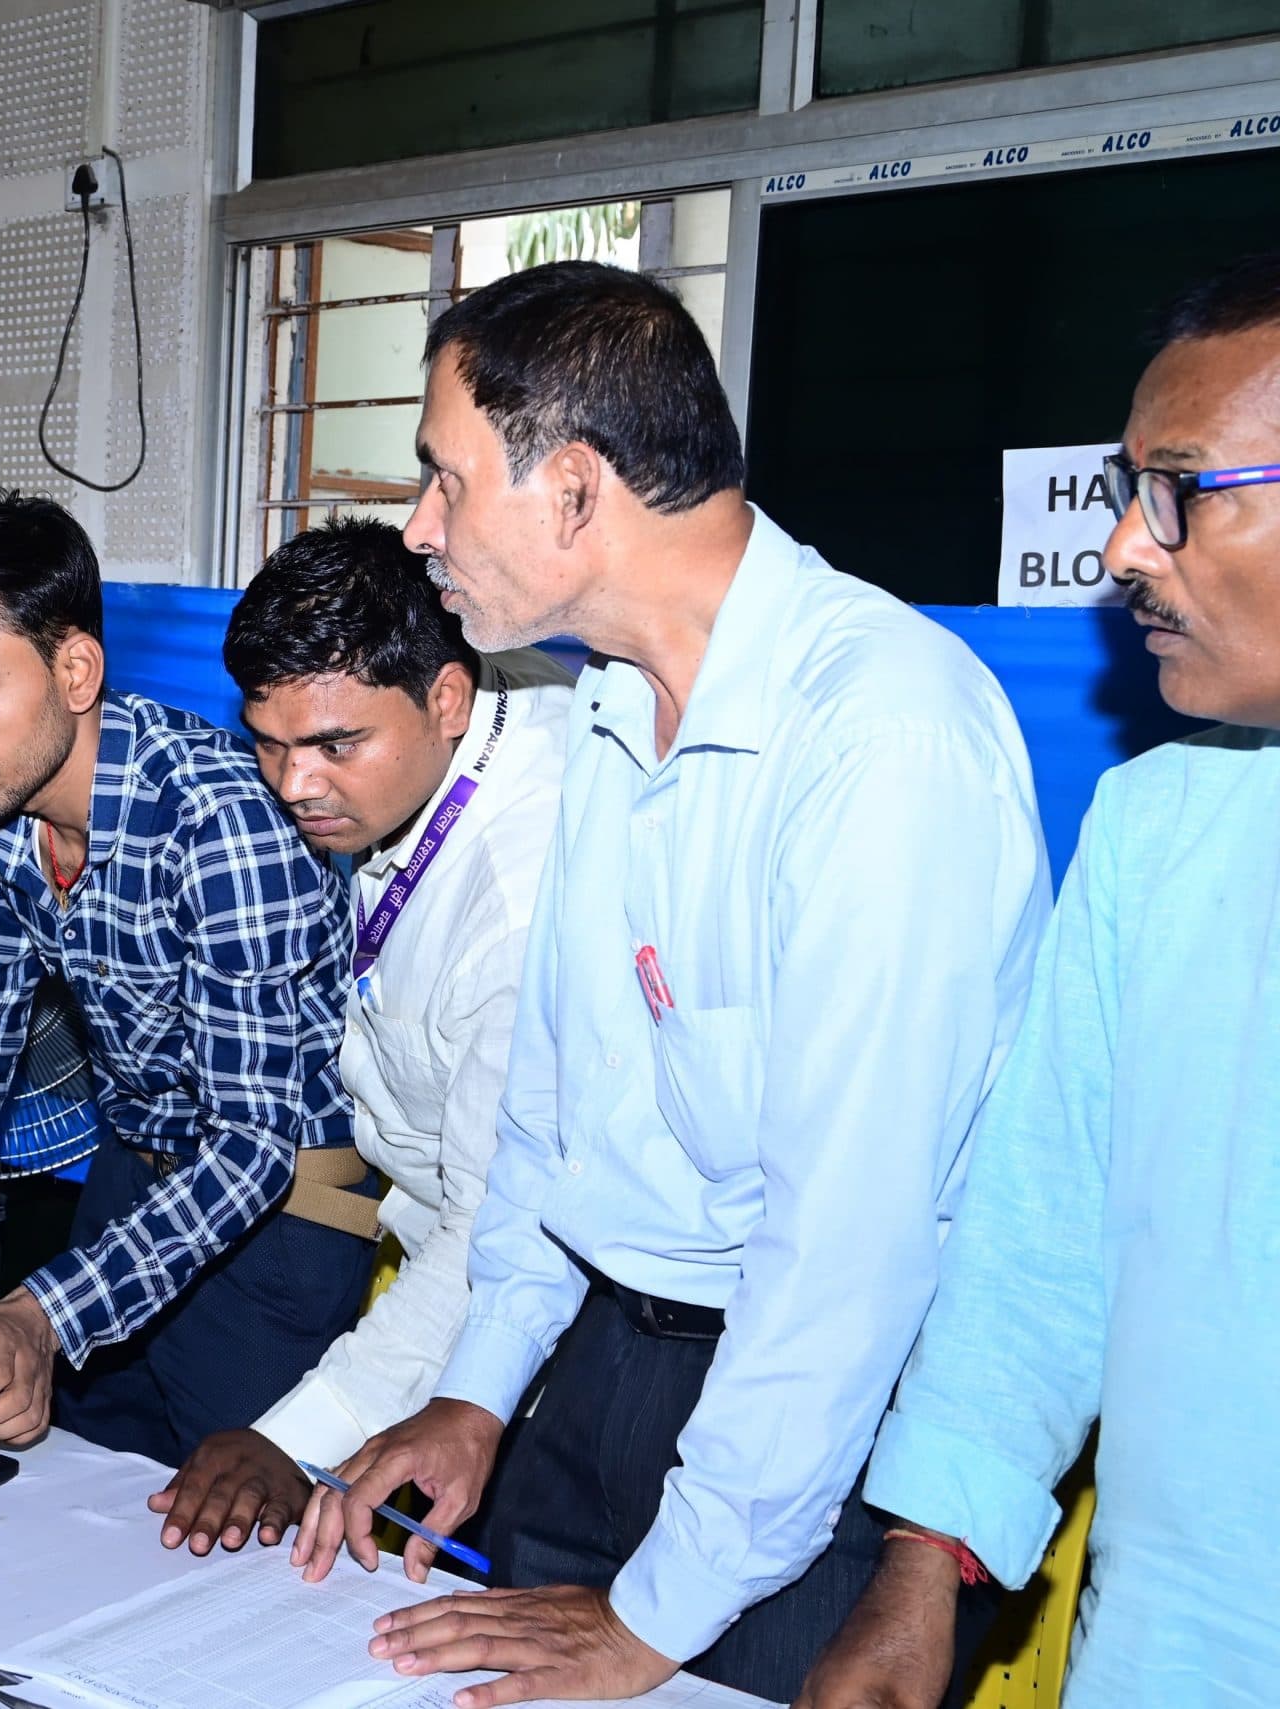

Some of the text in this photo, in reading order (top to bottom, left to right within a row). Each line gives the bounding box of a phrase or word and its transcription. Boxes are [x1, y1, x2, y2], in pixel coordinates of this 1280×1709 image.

[766, 174, 806, 193] ALCO
[869, 161, 912, 181] ALCO
[983, 146, 1030, 166] ALCO
[1102, 131, 1152, 153] ALCO
[1230, 115, 1280, 137] ALCO
[1048, 473, 1114, 512] HA
[1020, 550, 1106, 587] BLO
[473, 690, 508, 773] CHAMPARAN
[434, 801, 464, 835] जिला
[404, 836, 436, 881] प्रशासन
[389, 884, 407, 910] पूर्वी
